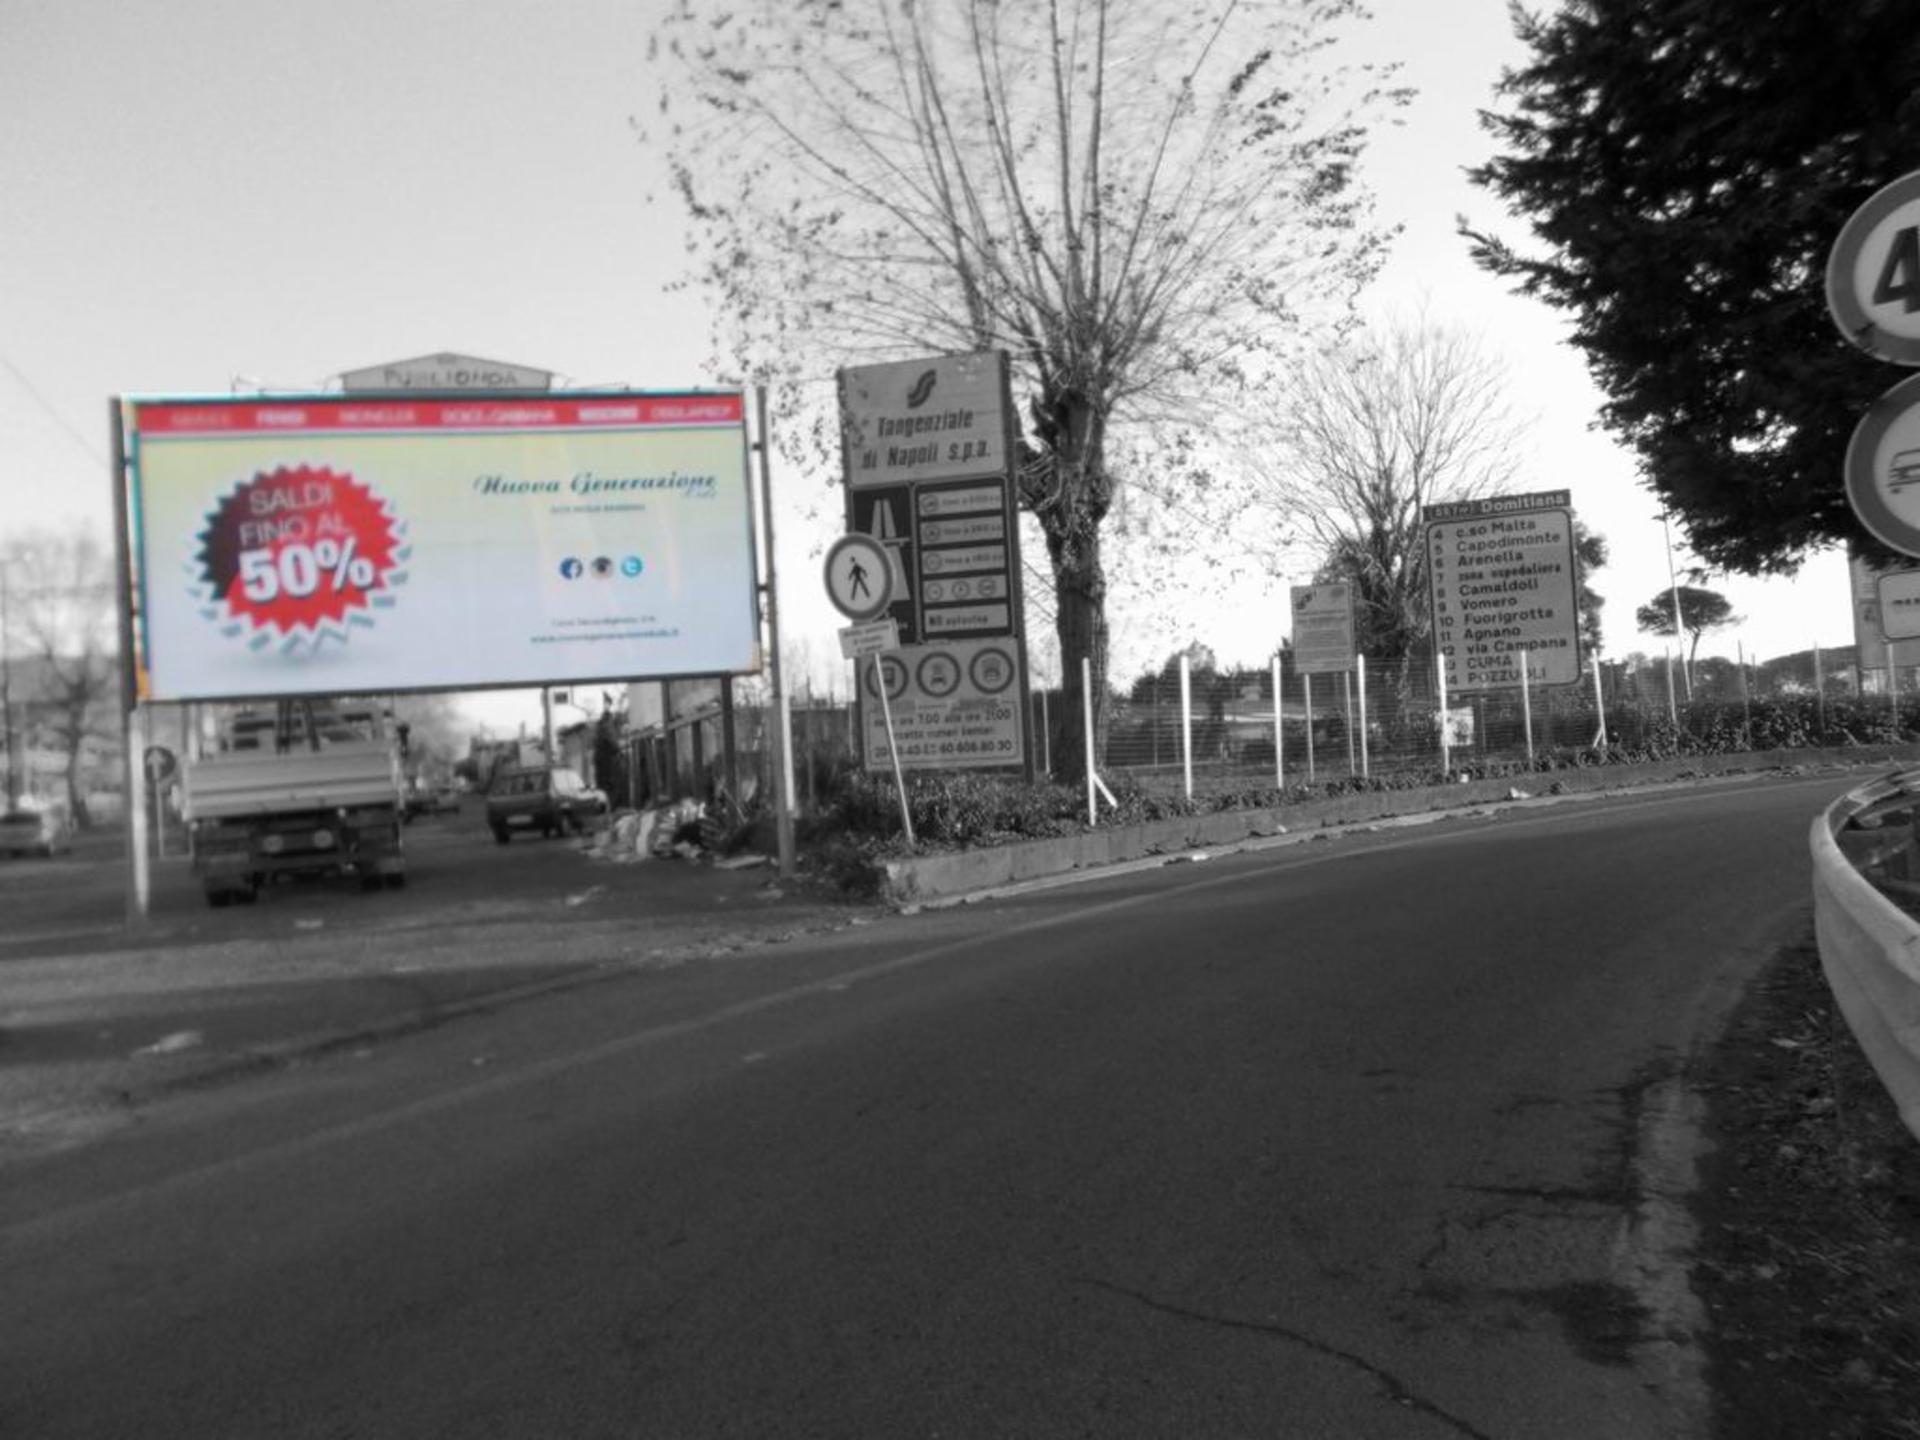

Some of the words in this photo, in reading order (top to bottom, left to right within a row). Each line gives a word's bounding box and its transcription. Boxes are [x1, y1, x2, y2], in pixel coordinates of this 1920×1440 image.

[1873, 225, 1920, 314] 4
[887, 443, 938, 467] Napoli
[249, 480, 333, 514] SALDI
[1480, 493, 1564, 514] Domitiana
[239, 515, 310, 545] FINO
[1434, 529, 1443, 540] 4
[1491, 519, 1536, 534] Malta
[1456, 531, 1561, 552] Capodimonte
[239, 536, 374, 602] 50%
[1458, 551, 1524, 567] Arenella
[1458, 578, 1539, 597] Camaldoli
[1460, 596, 1518, 610] Vomero
[1439, 616, 1454, 627] 10
[1464, 607, 1554, 625] Fuorigrotta
[1464, 625, 1521, 642] Agnano
[1466, 643, 1488, 655] via
[1494, 638, 1567, 653] Campana
